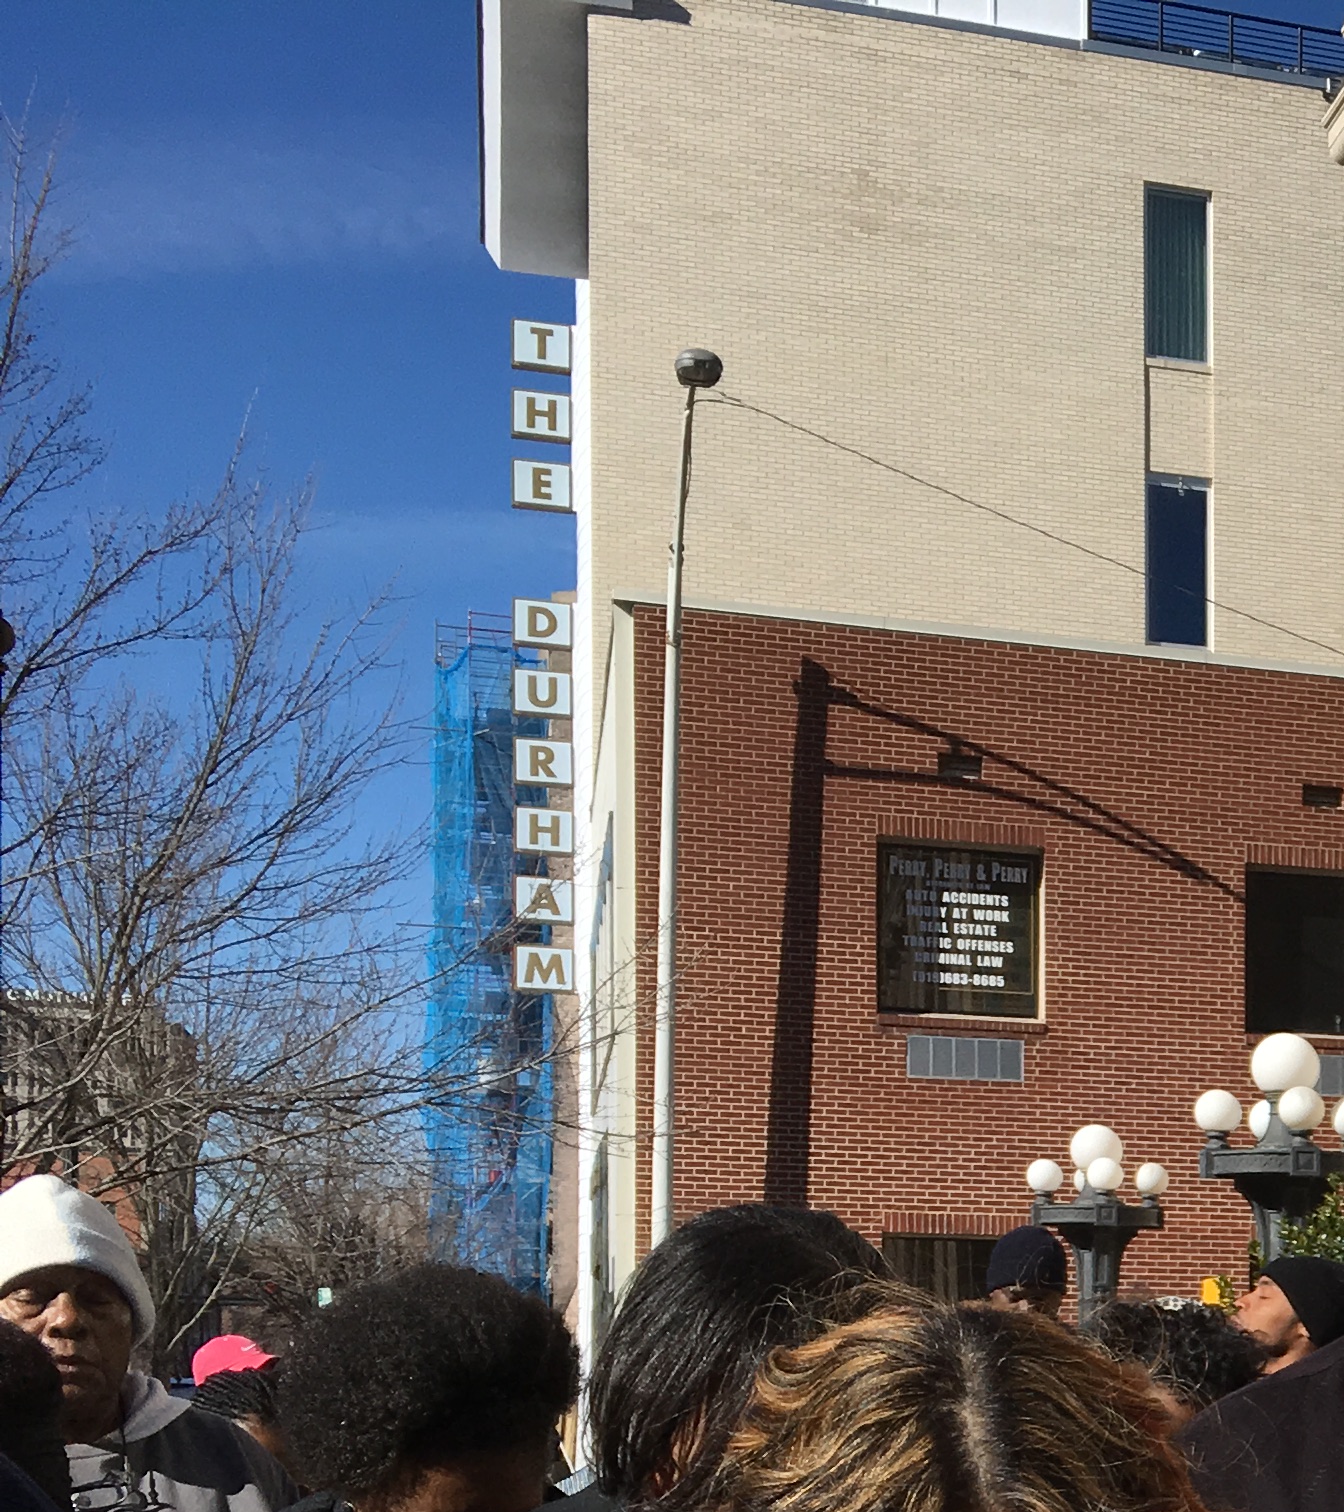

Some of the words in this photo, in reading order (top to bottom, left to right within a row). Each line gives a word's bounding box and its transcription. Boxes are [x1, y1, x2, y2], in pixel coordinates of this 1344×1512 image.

[526, 327, 557, 500] THE
[524, 605, 566, 986] DURHAM
[976, 864, 987, 881] &
[992, 862, 1028, 883] PERRY
[941, 891, 1009, 907] ACCIDENTS
[952, 907, 968, 920] AT
[973, 908, 1009, 922] WORK
[920, 921, 948, 934] REAL
[953, 922, 997, 937] ESTATE
[902, 935, 952, 950] TRAFFIC
[957, 938, 1014, 953] OFFENSES
[977, 955, 1003, 968] LAW
